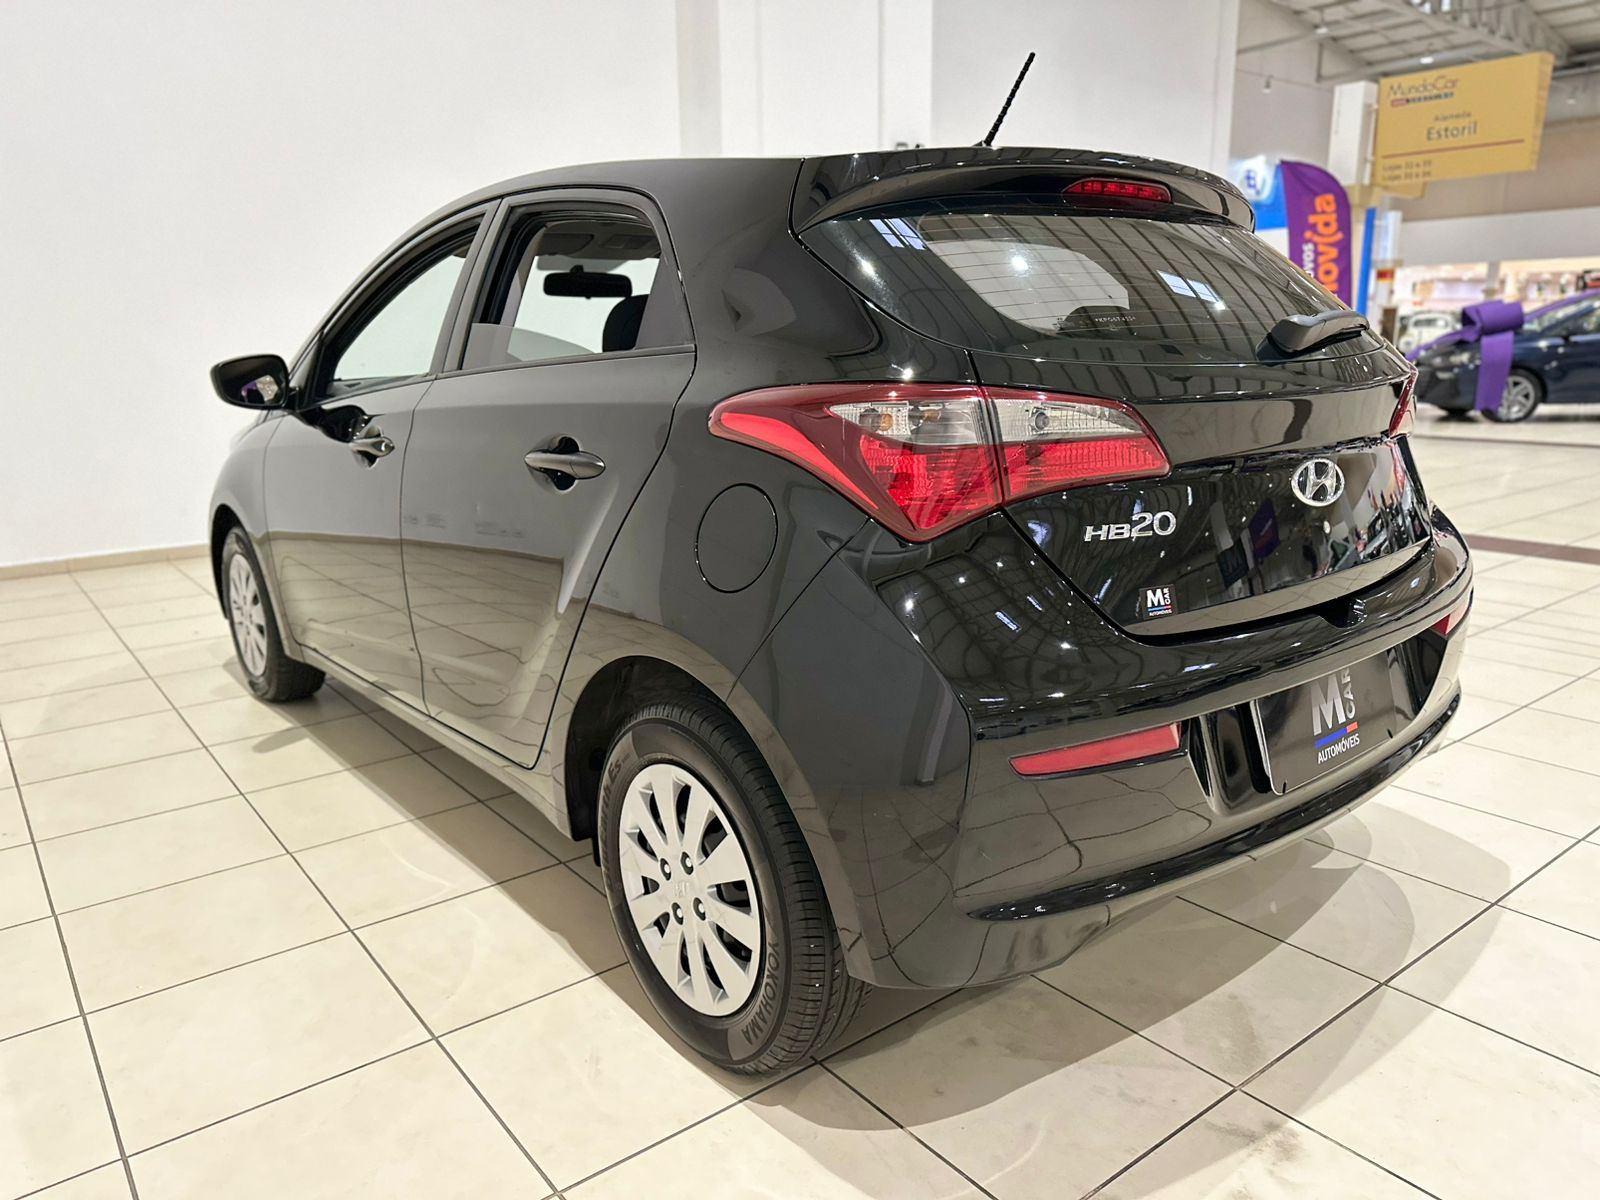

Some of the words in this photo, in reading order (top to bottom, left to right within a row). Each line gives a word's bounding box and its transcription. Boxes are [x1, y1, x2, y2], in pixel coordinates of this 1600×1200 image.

[1426, 121, 1478, 141] Estoril
[1084, 511, 1177, 542] HB20
[1310, 673, 1347, 736] M
[1341, 667, 1356, 719] CAR
[1317, 733, 1360, 764] AUTOMÓVEIS
[741, 941, 780, 1046] YOKOHAMA
